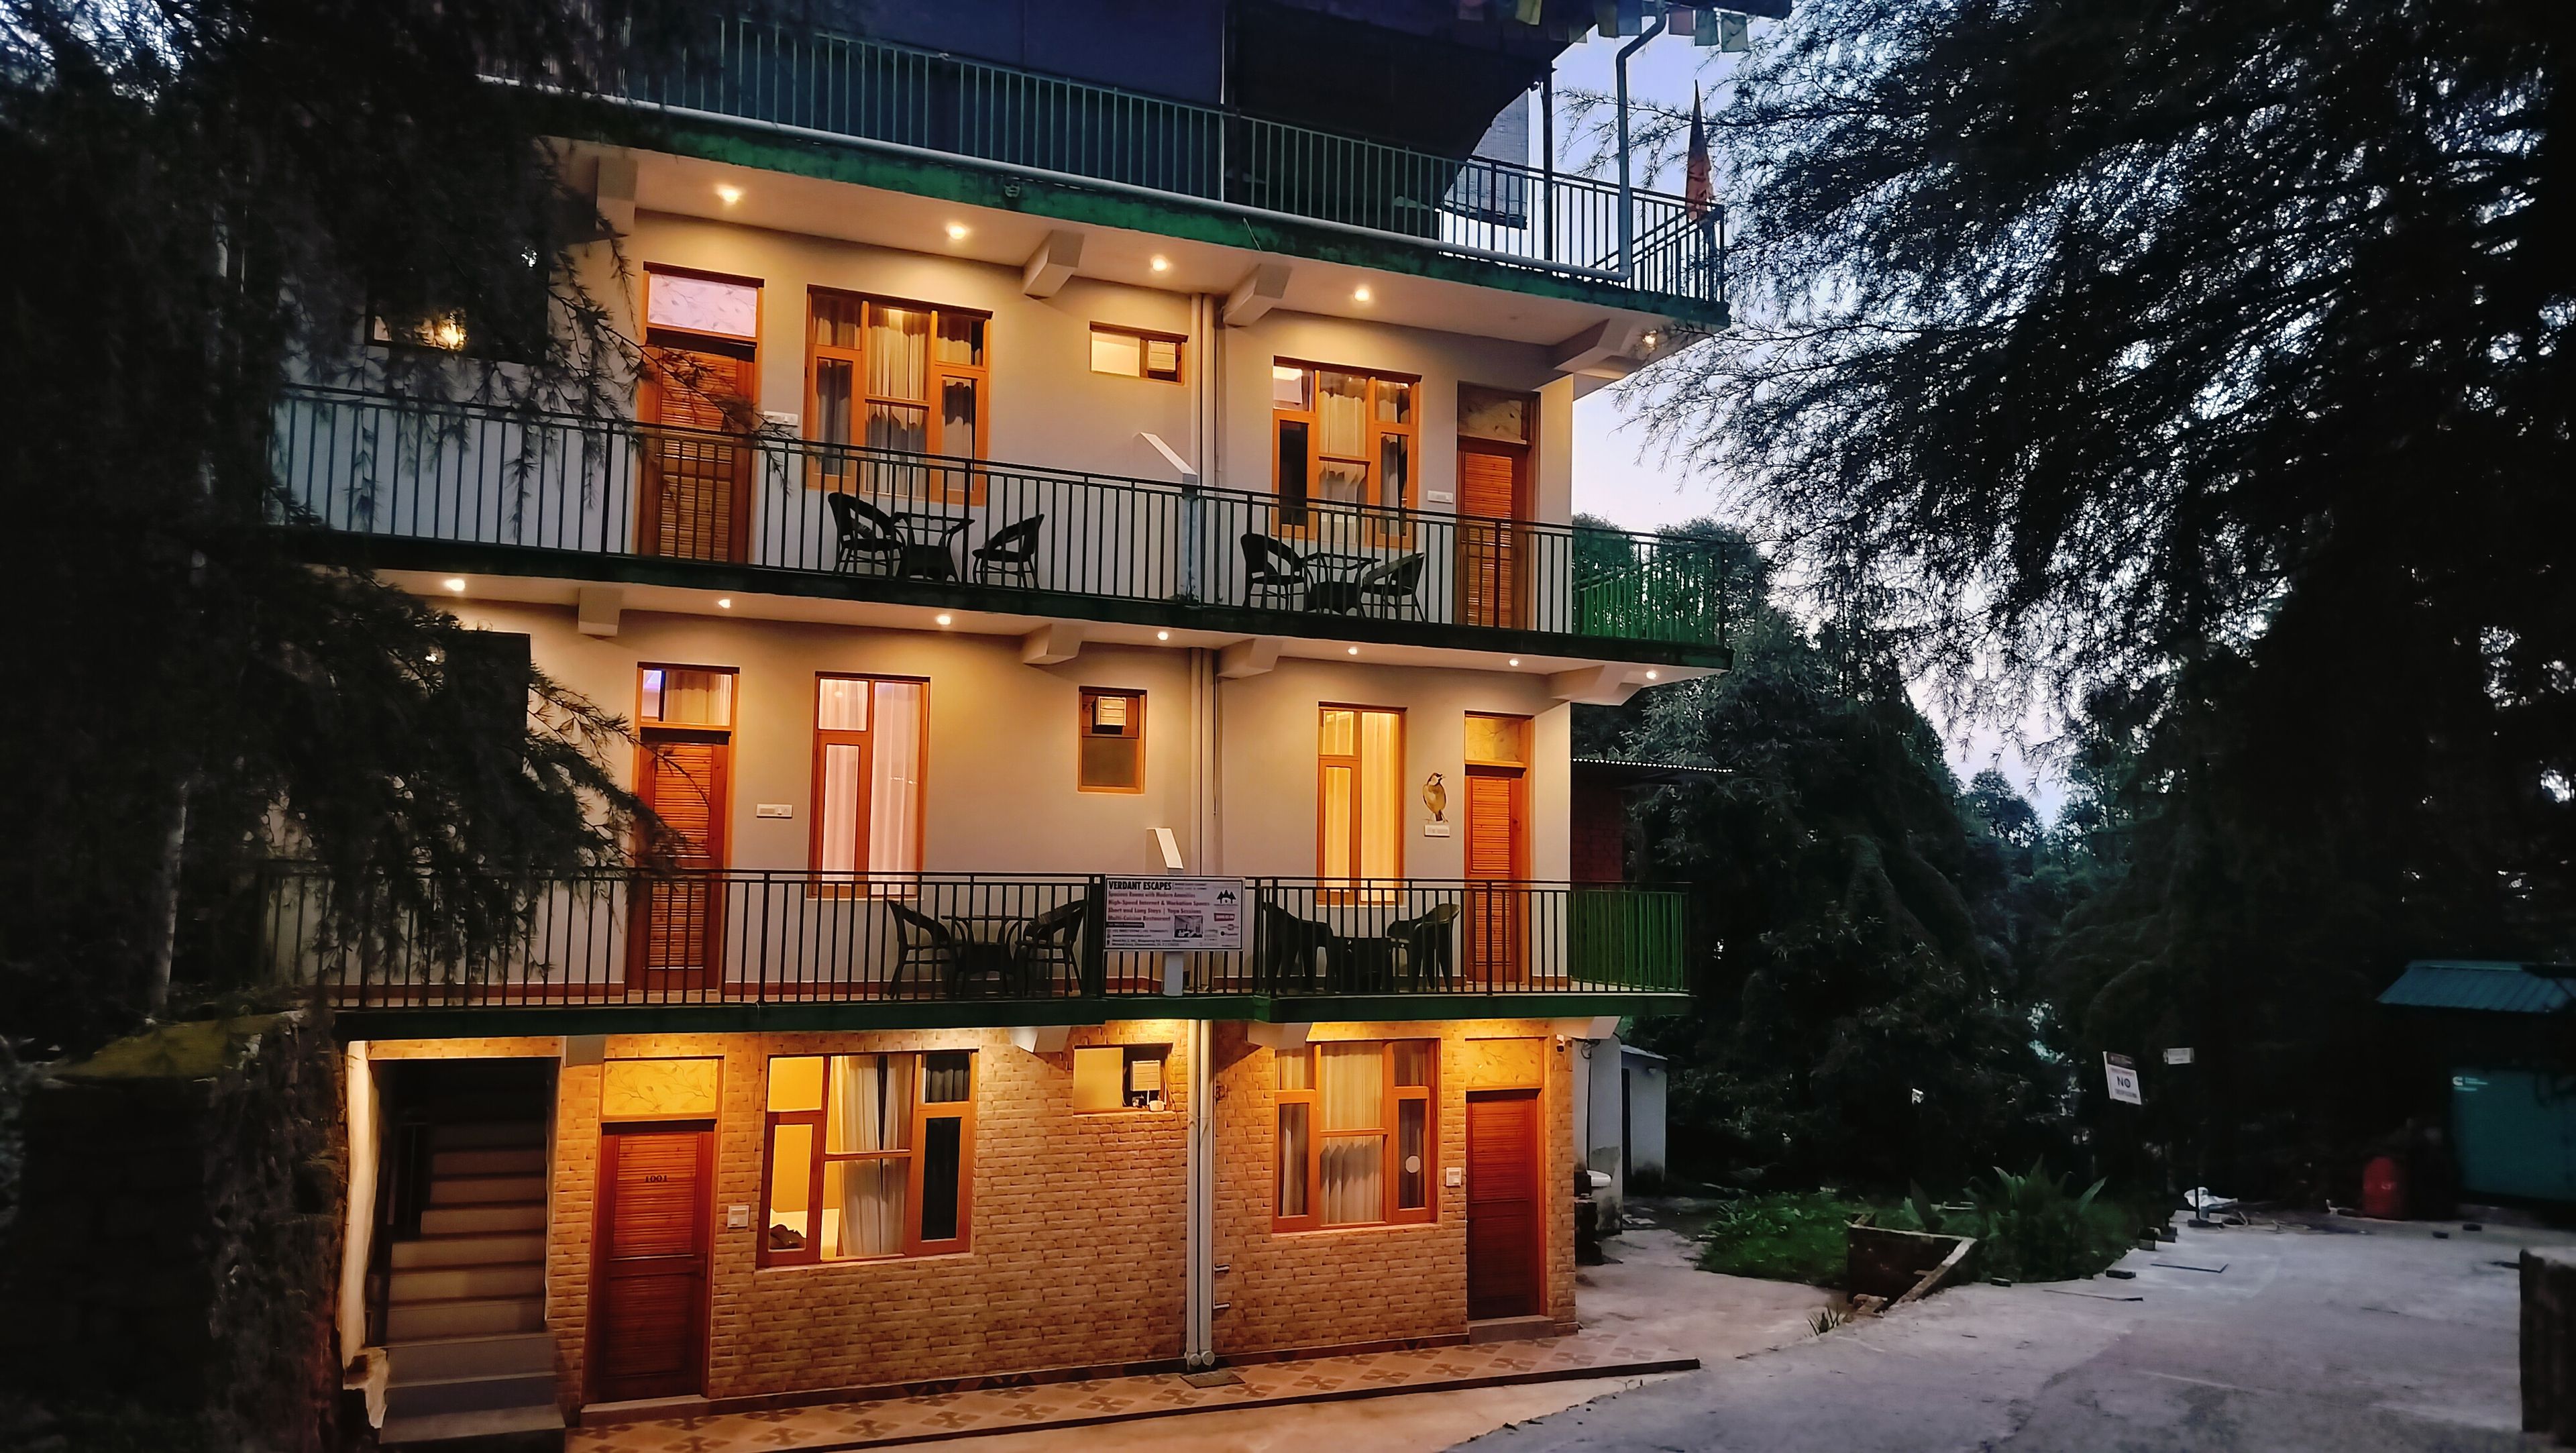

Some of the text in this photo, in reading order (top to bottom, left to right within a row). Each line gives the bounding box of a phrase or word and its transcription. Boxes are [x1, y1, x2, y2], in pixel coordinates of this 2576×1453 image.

[1109, 881, 1171, 890] VERDANT ESCAPES
[2116, 1076, 2131, 1088] NO
[645, 1175, 668, 1183] 1001
